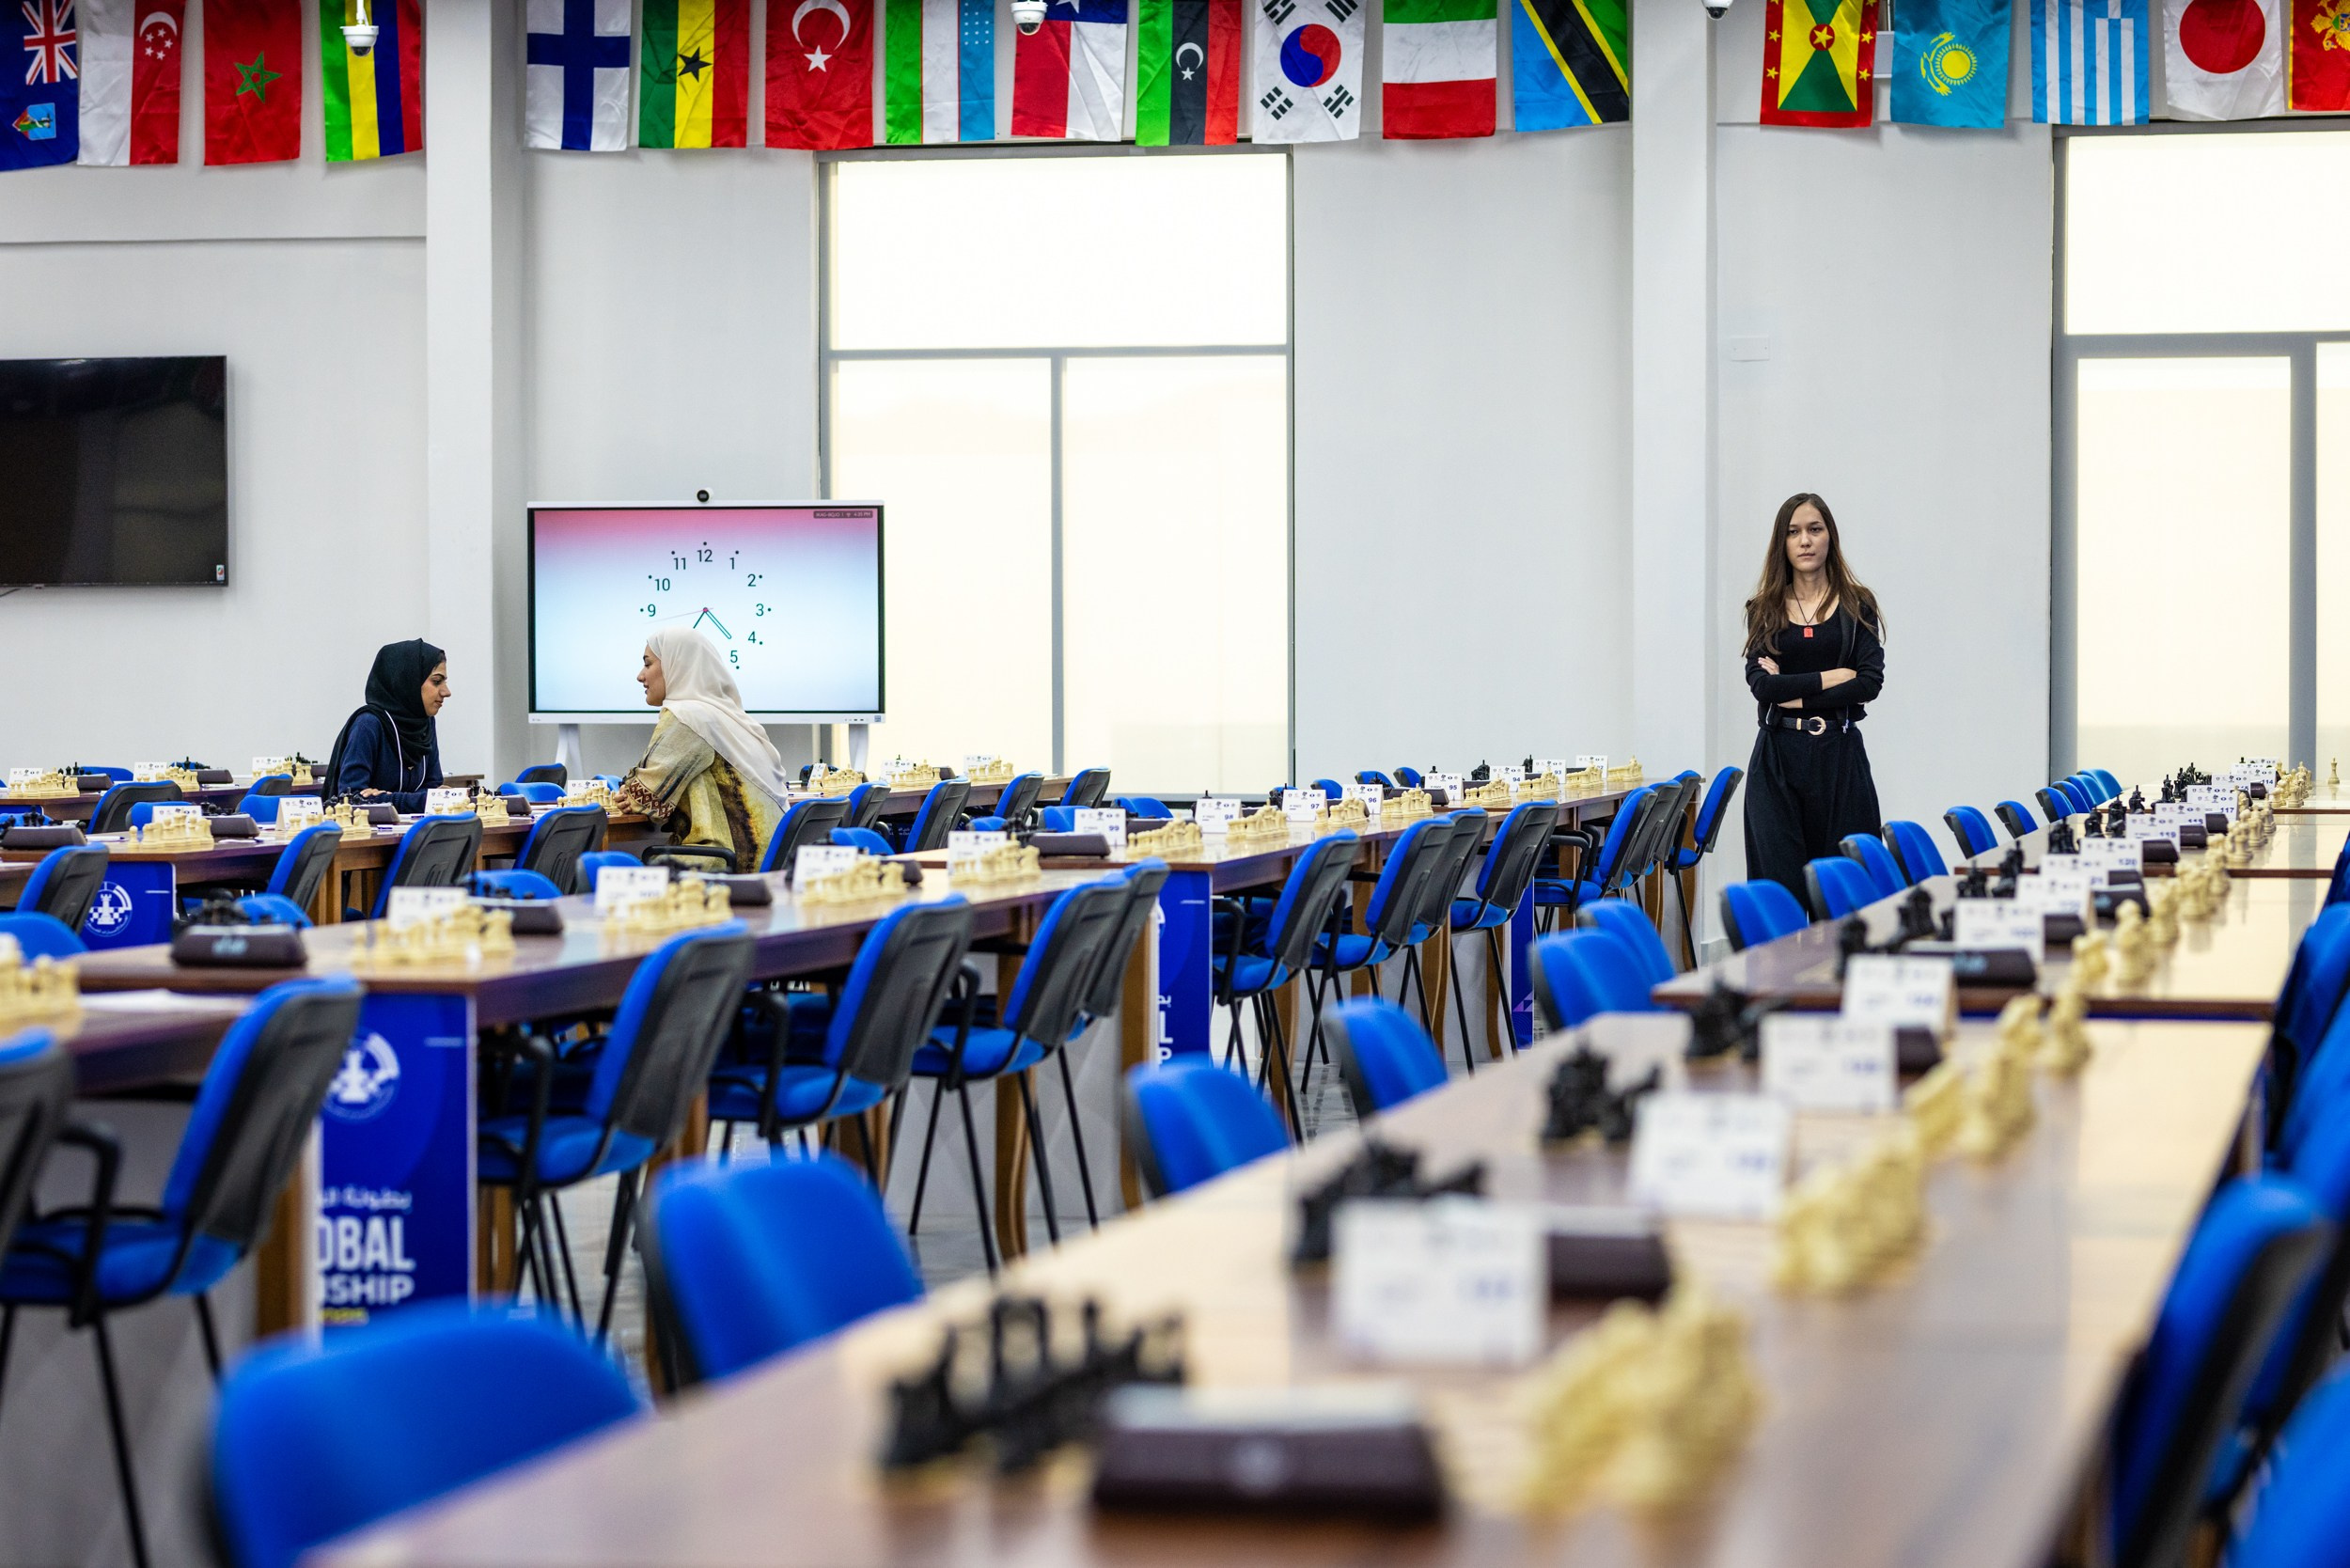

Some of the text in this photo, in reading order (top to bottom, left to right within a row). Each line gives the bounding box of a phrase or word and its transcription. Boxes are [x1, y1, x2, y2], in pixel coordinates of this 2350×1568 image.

[697, 549, 713, 563] 12
[673, 557, 687, 571] 11
[728, 557, 735, 571] 1
[654, 578, 671, 591] 10
[747, 573, 757, 588] 2
[647, 604, 656, 618] 9
[756, 604, 764, 617] 3
[747, 631, 757, 644] 4
[729, 650, 739, 664] 5
